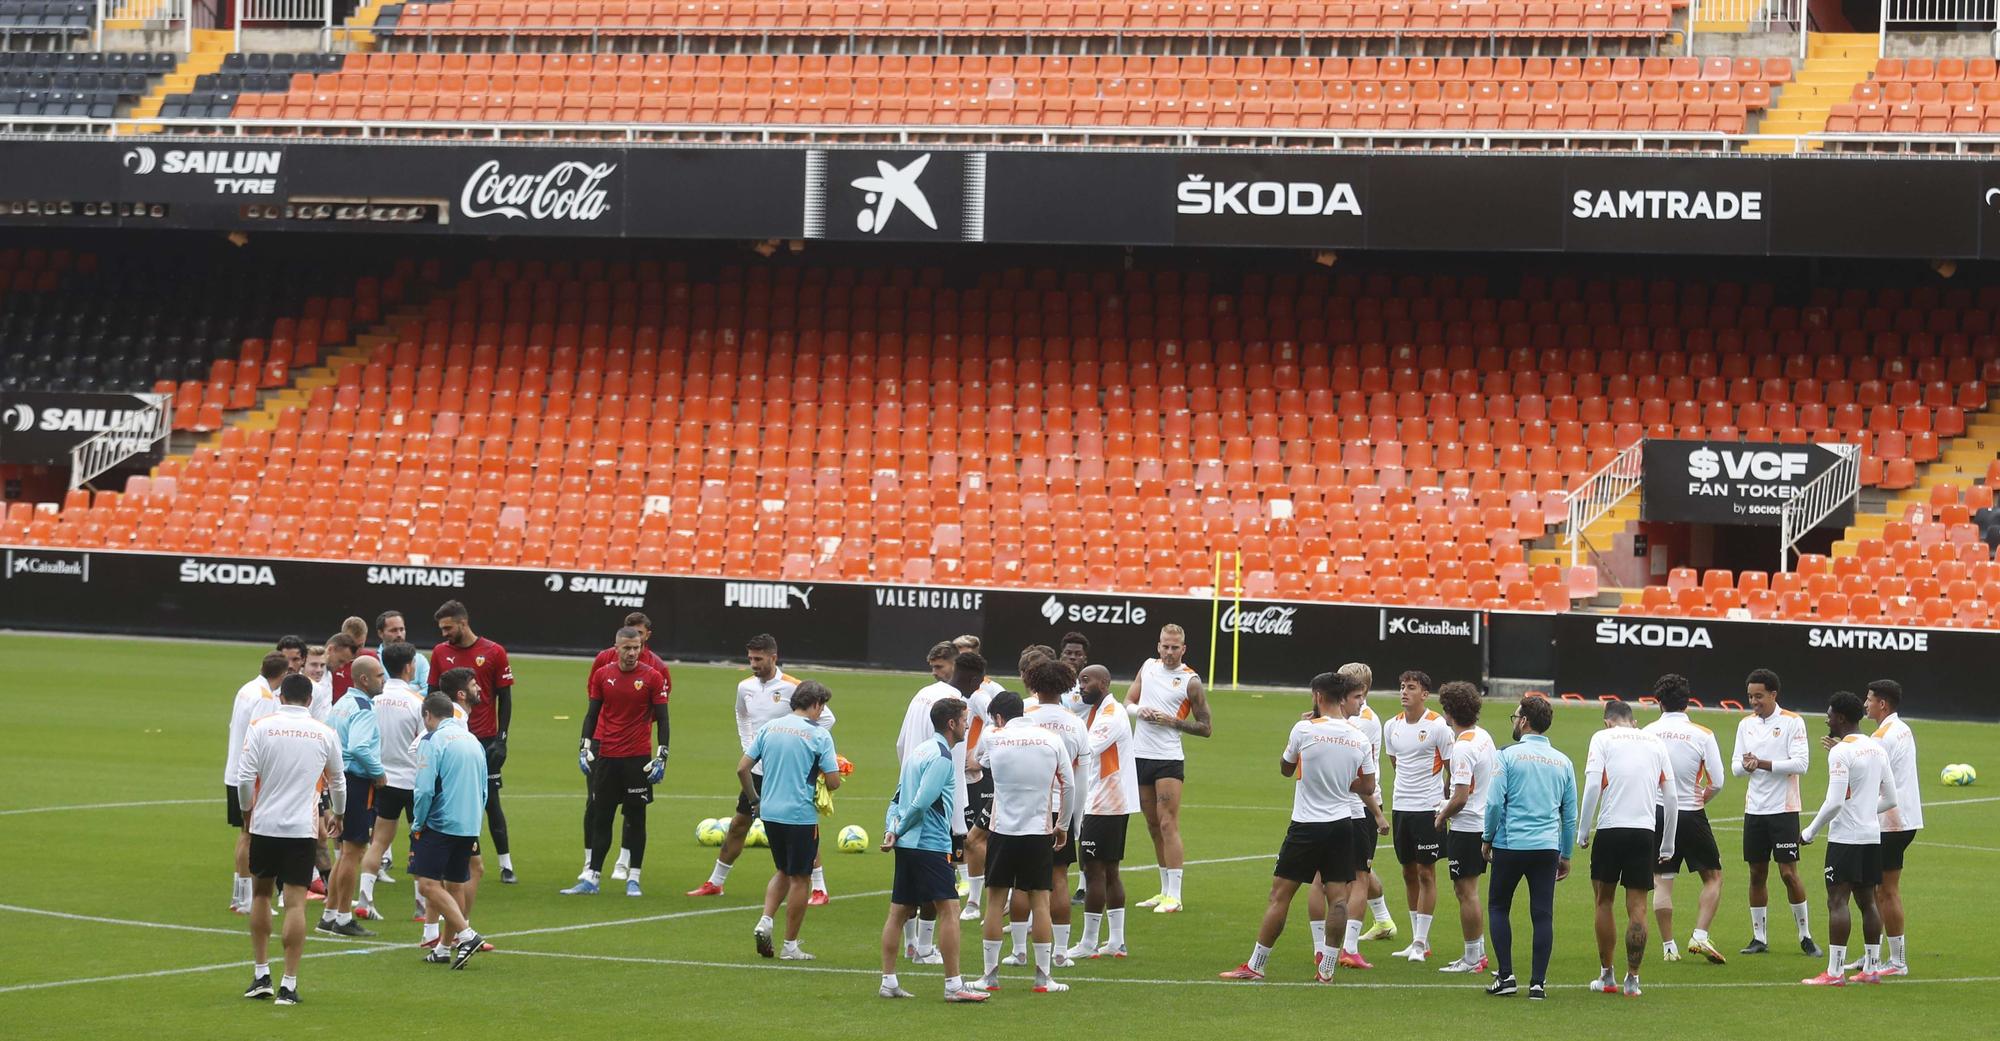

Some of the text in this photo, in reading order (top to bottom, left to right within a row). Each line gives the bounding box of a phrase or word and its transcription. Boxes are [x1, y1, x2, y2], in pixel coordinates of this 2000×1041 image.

[162, 150, 281, 175] SAILUN
[214, 178, 275, 194] TYRE
[460, 159, 618, 221] Coca-Cola
[1177, 173, 1363, 216] ŠKODA
[1572, 189, 1762, 220] SAMTRADE
[40, 407, 157, 432] SAILUN
[1688, 446, 1808, 482] $VCF
[1688, 482, 1805, 500] FAN TOKEN
[1733, 502, 1747, 515] by
[29, 557, 82, 575] CaixaBank
[179, 558, 276, 586] ŠKODA
[367, 566, 465, 588] SAMTRADE
[569, 576, 648, 595] SAILUN
[724, 582, 788, 609] PUMA
[603, 596, 645, 608] TYRE
[1068, 600, 1147, 625] sezzle
[1220, 604, 1298, 636] Coca-Cola
[1407, 618, 1471, 637] CaixaBank
[1596, 617, 1714, 649] ŠKODA
[1808, 632, 1929, 653] SAMTRADE
[268, 728, 324, 741] SAMTRADE
[1314, 735, 1361, 749] SAMTRADE
